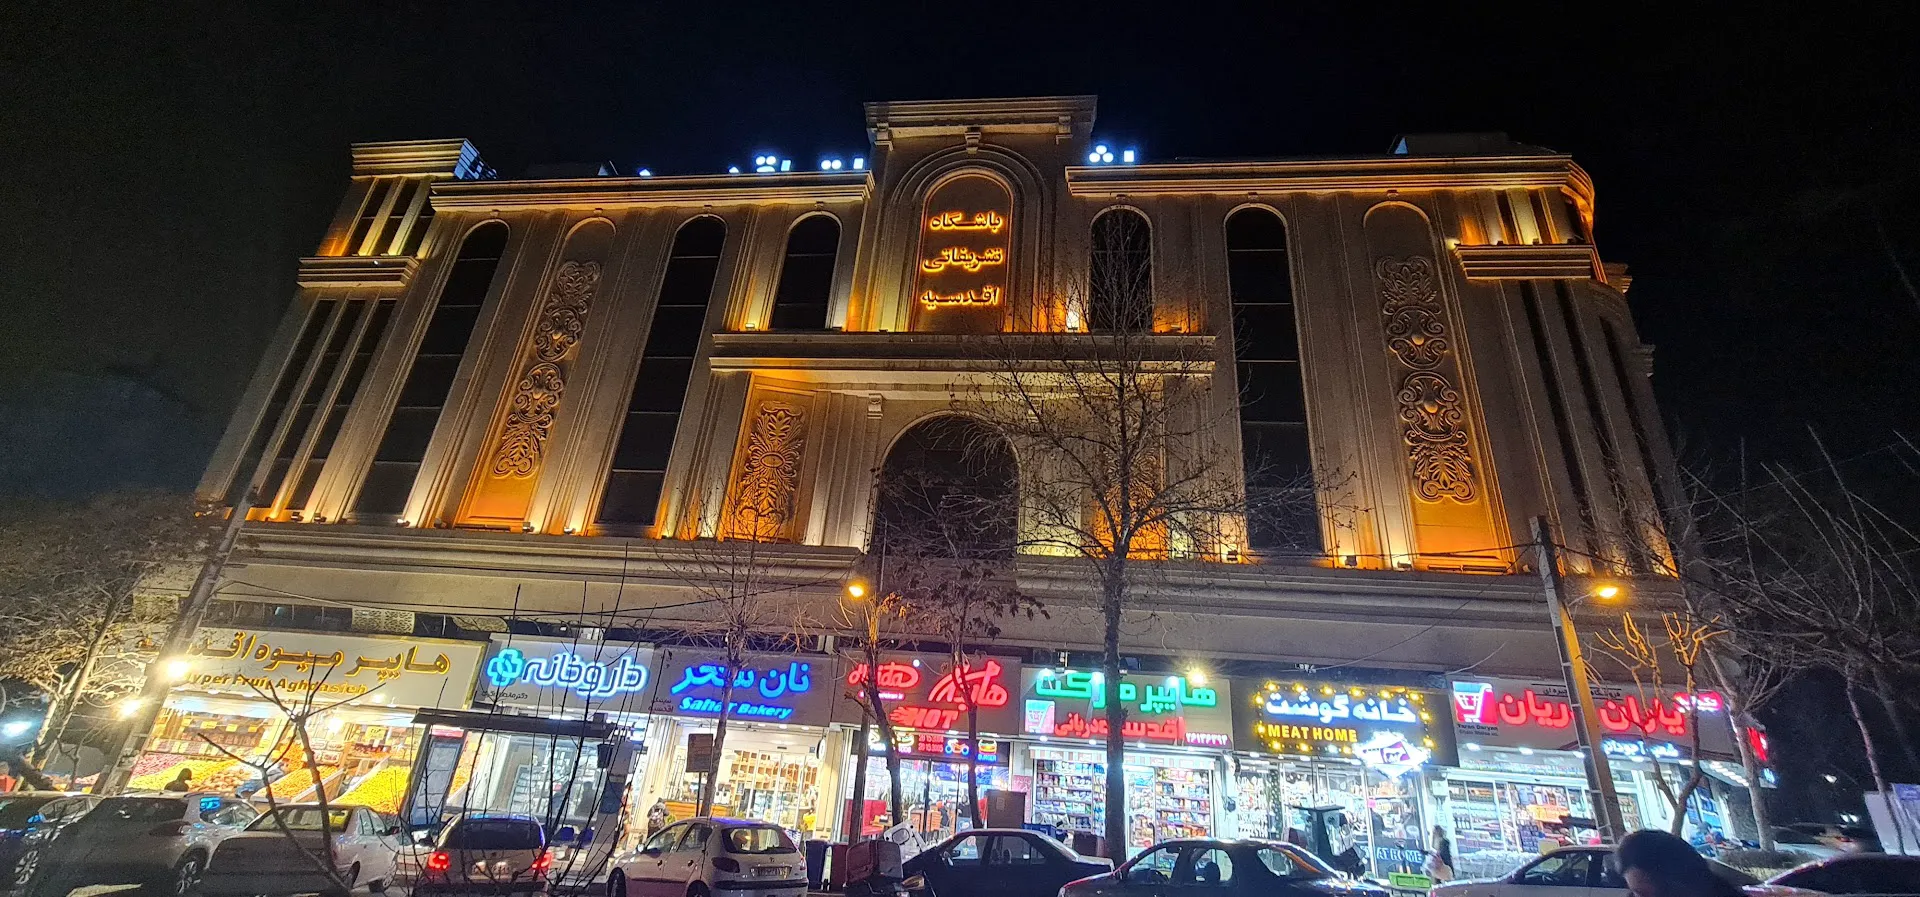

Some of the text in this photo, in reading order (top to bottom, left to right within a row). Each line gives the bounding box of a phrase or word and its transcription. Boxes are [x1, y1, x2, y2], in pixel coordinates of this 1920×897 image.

[930, 211, 1003, 233] باشگاه
[922, 247, 1003, 272] تشریفاتی
[921, 286, 999, 309] اقدسیه
[254, 642, 344, 673] میوه
[344, 644, 451, 682] هایپر
[275, 677, 369, 695] Aghdasieh
[522, 651, 648, 698] داروخانه
[759, 661, 811, 698] نان
[1035, 671, 1218, 714] هایپر مرکت
[1265, 690, 1417, 723] خانه گوشت
[737, 702, 793, 720] Bakery
[906, 706, 960, 729] HOT
[1498, 688, 1575, 729] ریان
[1600, 696, 1687, 735] یاران
[1268, 724, 1358, 743] MEAT HOME
